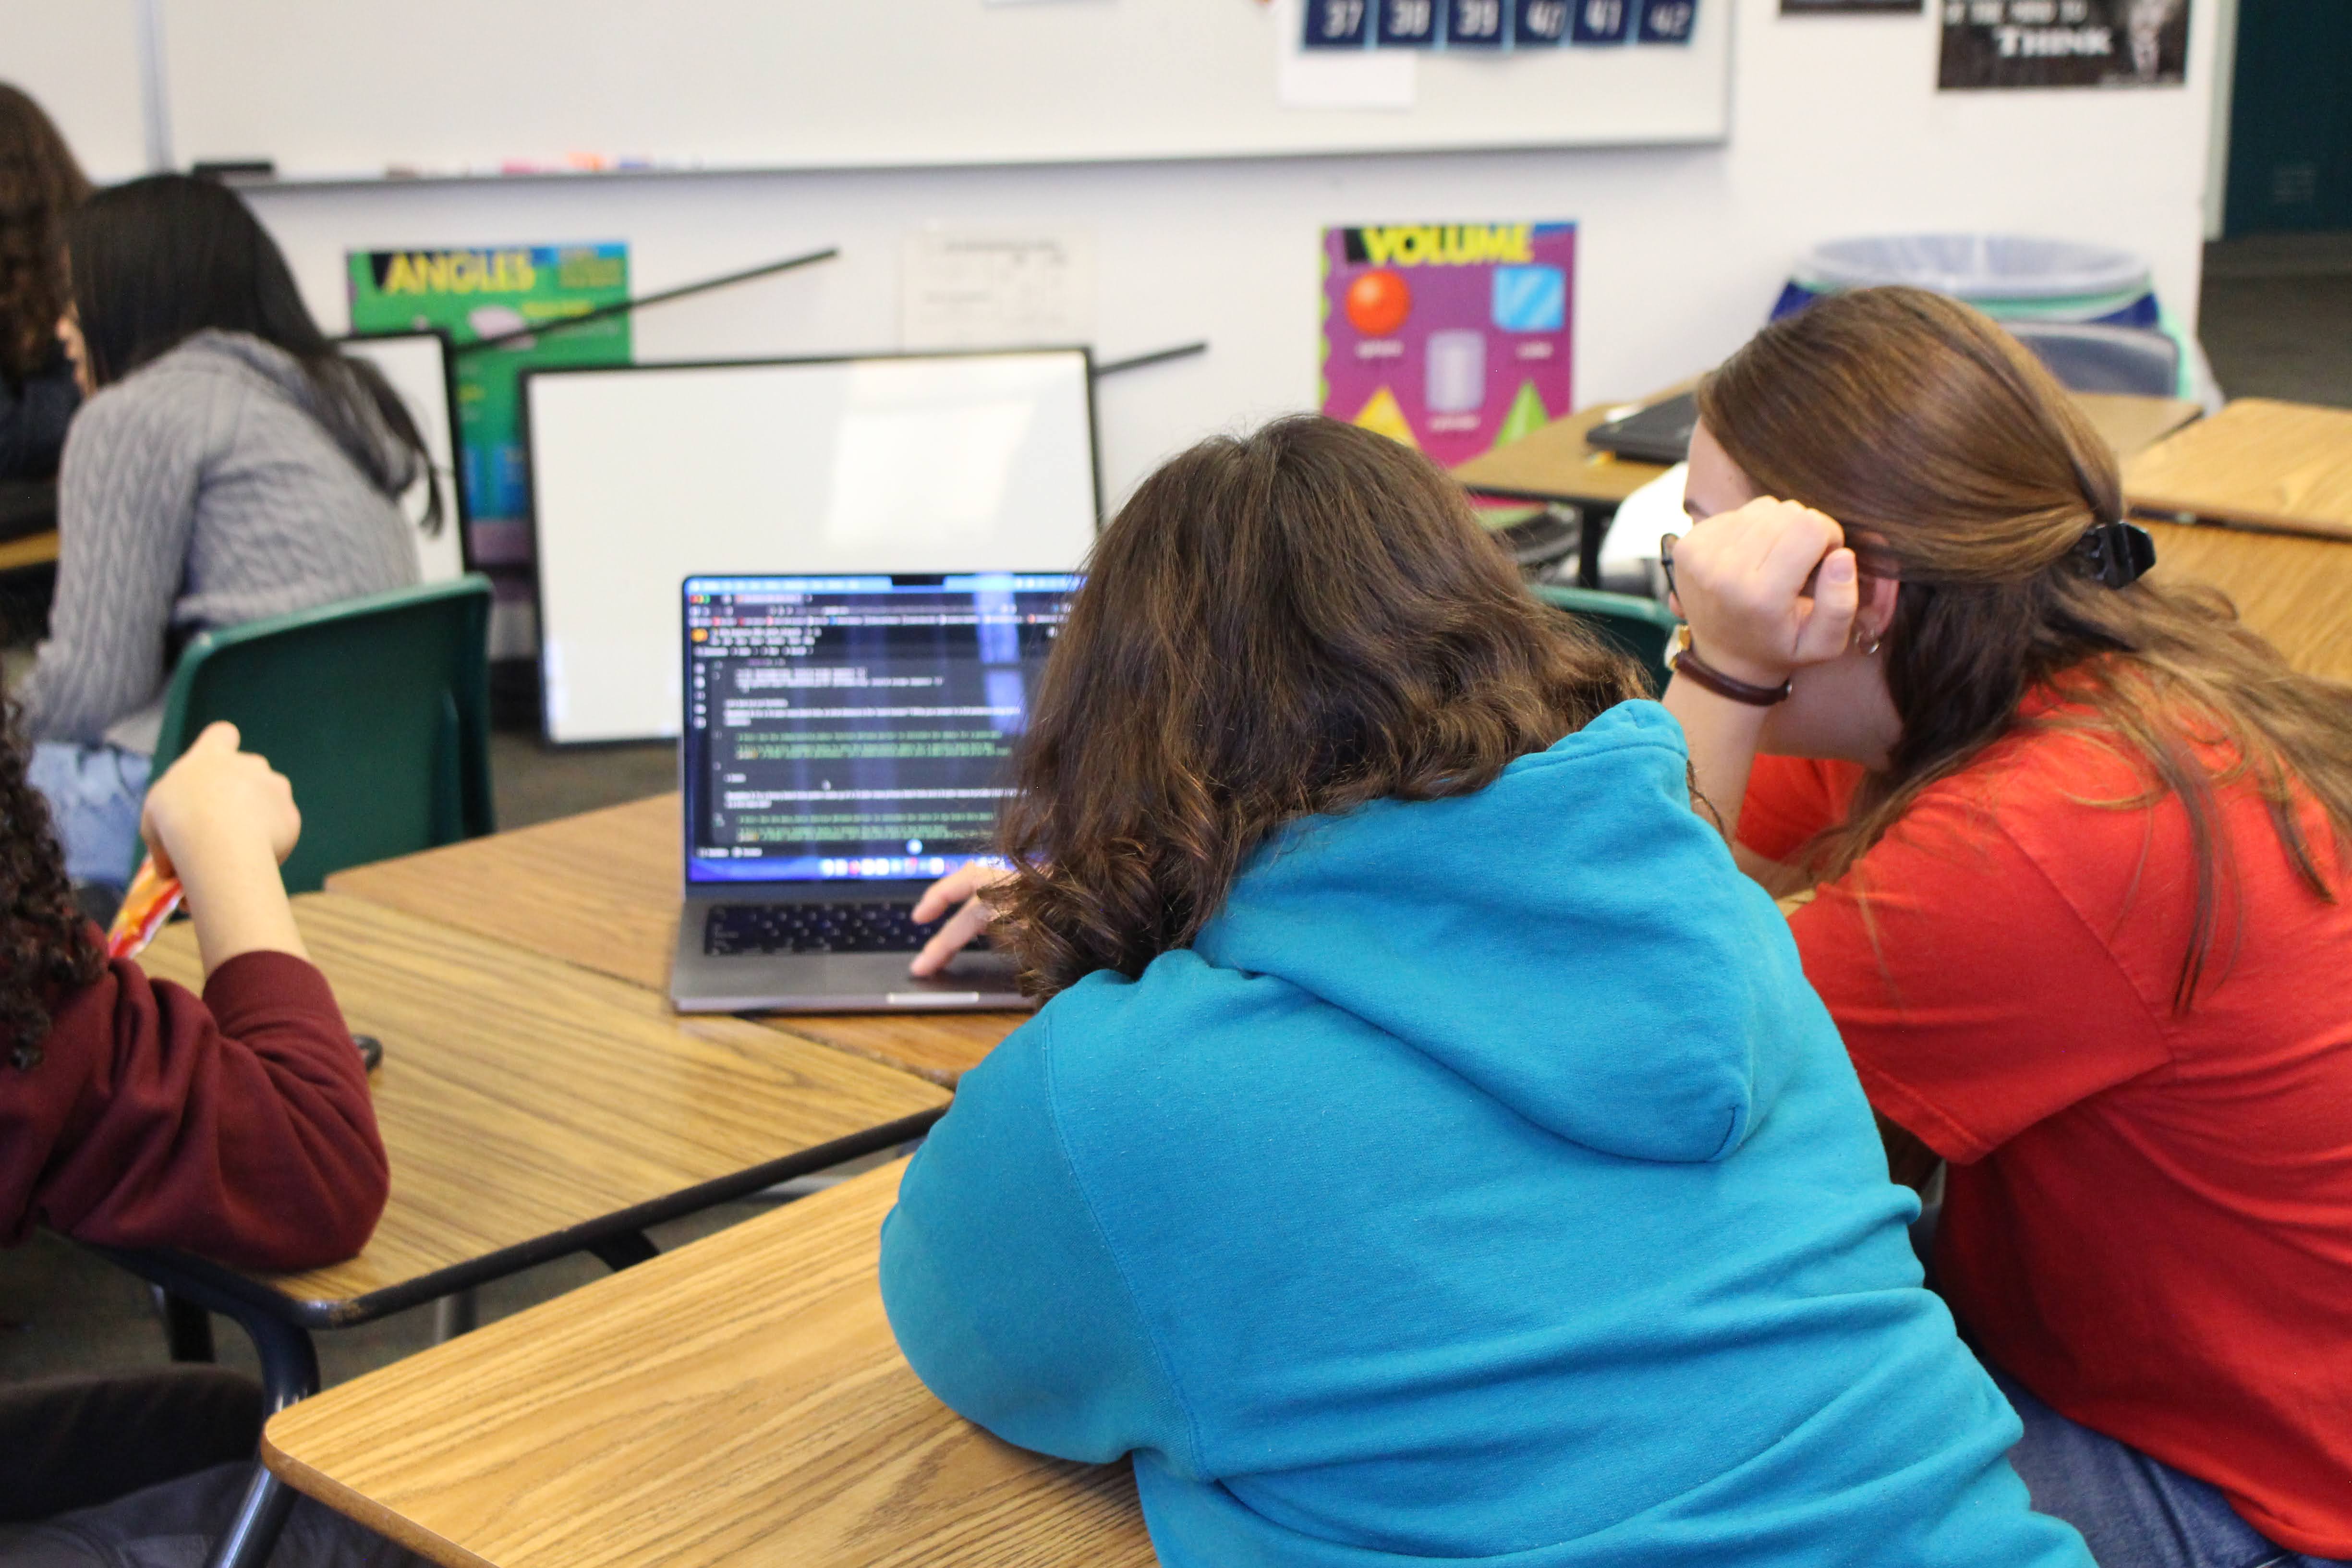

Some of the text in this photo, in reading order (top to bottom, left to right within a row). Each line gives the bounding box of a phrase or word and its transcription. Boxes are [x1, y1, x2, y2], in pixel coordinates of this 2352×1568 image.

[1323, 0, 1692, 37] 37 38 39 40 41 42
[1994, 27, 2112, 57] THINK
[1359, 222, 1534, 266] VOLUME
[386, 250, 536, 294] ANGLES
